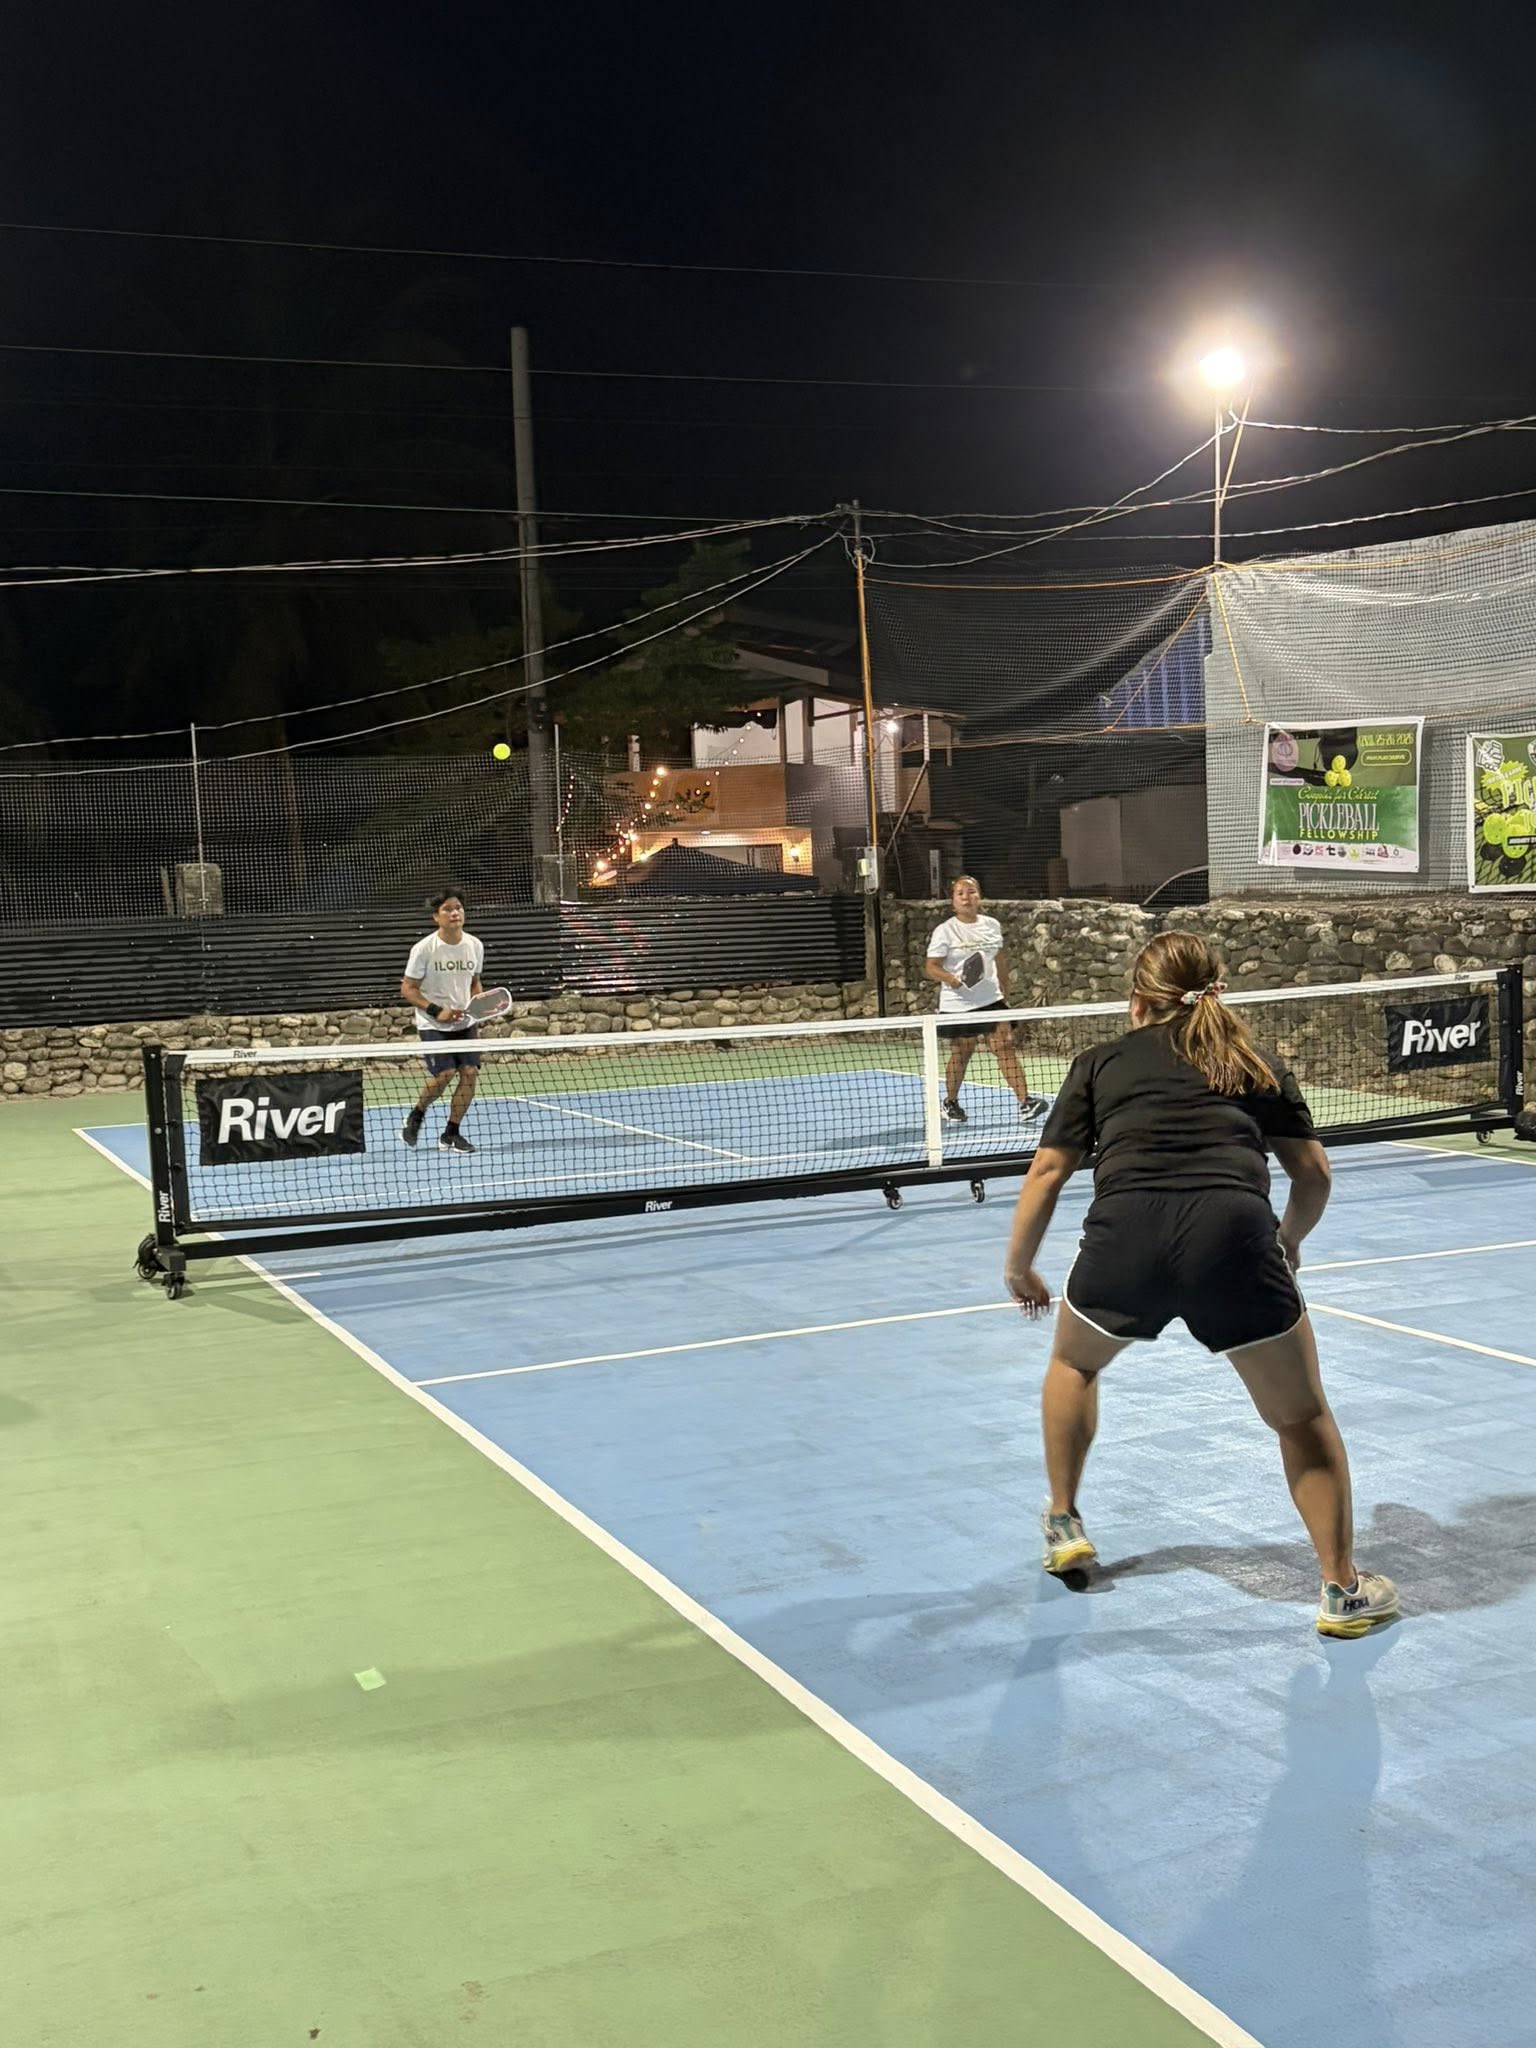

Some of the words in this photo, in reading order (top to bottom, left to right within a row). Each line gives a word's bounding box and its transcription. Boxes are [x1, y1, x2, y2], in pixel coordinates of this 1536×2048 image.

[1502, 776, 1536, 808] PIC
[1298, 803, 1380, 831] PICKLEBALL
[1299, 828, 1379, 840] FELLOWSHIP
[434, 960, 475, 971] ILOILO
[1401, 1018, 1482, 1057] River
[233, 1049, 257, 1059] River
[1516, 1071, 1524, 1096] River
[217, 1096, 346, 1145] River
[158, 1190, 169, 1223] River
[645, 1200, 672, 1212] River
